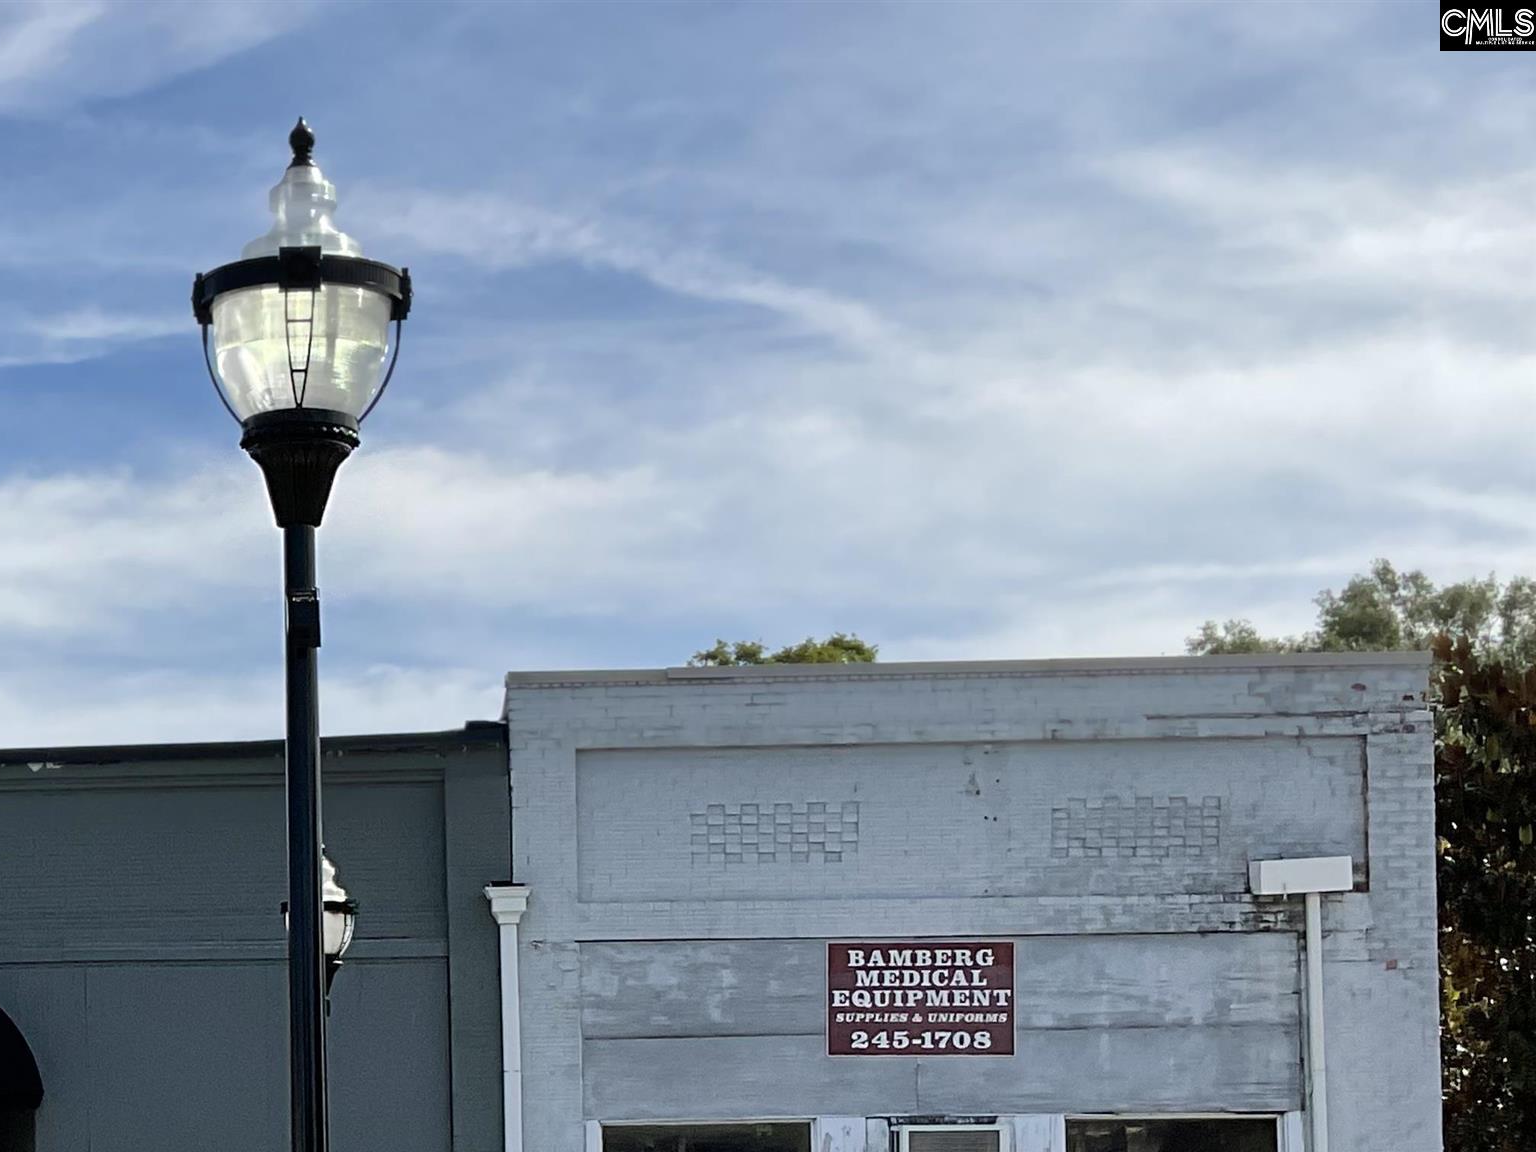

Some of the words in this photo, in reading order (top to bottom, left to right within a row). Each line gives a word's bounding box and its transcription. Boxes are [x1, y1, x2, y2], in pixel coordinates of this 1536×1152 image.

[847, 949, 995, 967] BAMBERG
[855, 970, 987, 987] MEDICAL
[831, 989, 1011, 1008] EQUIPMENT
[835, 1012, 909, 1023] SUPPLIES
[911, 1012, 923, 1023] &
[927, 1012, 1008, 1023] UNIFORMS
[850, 1031, 992, 1049] 245-1708
